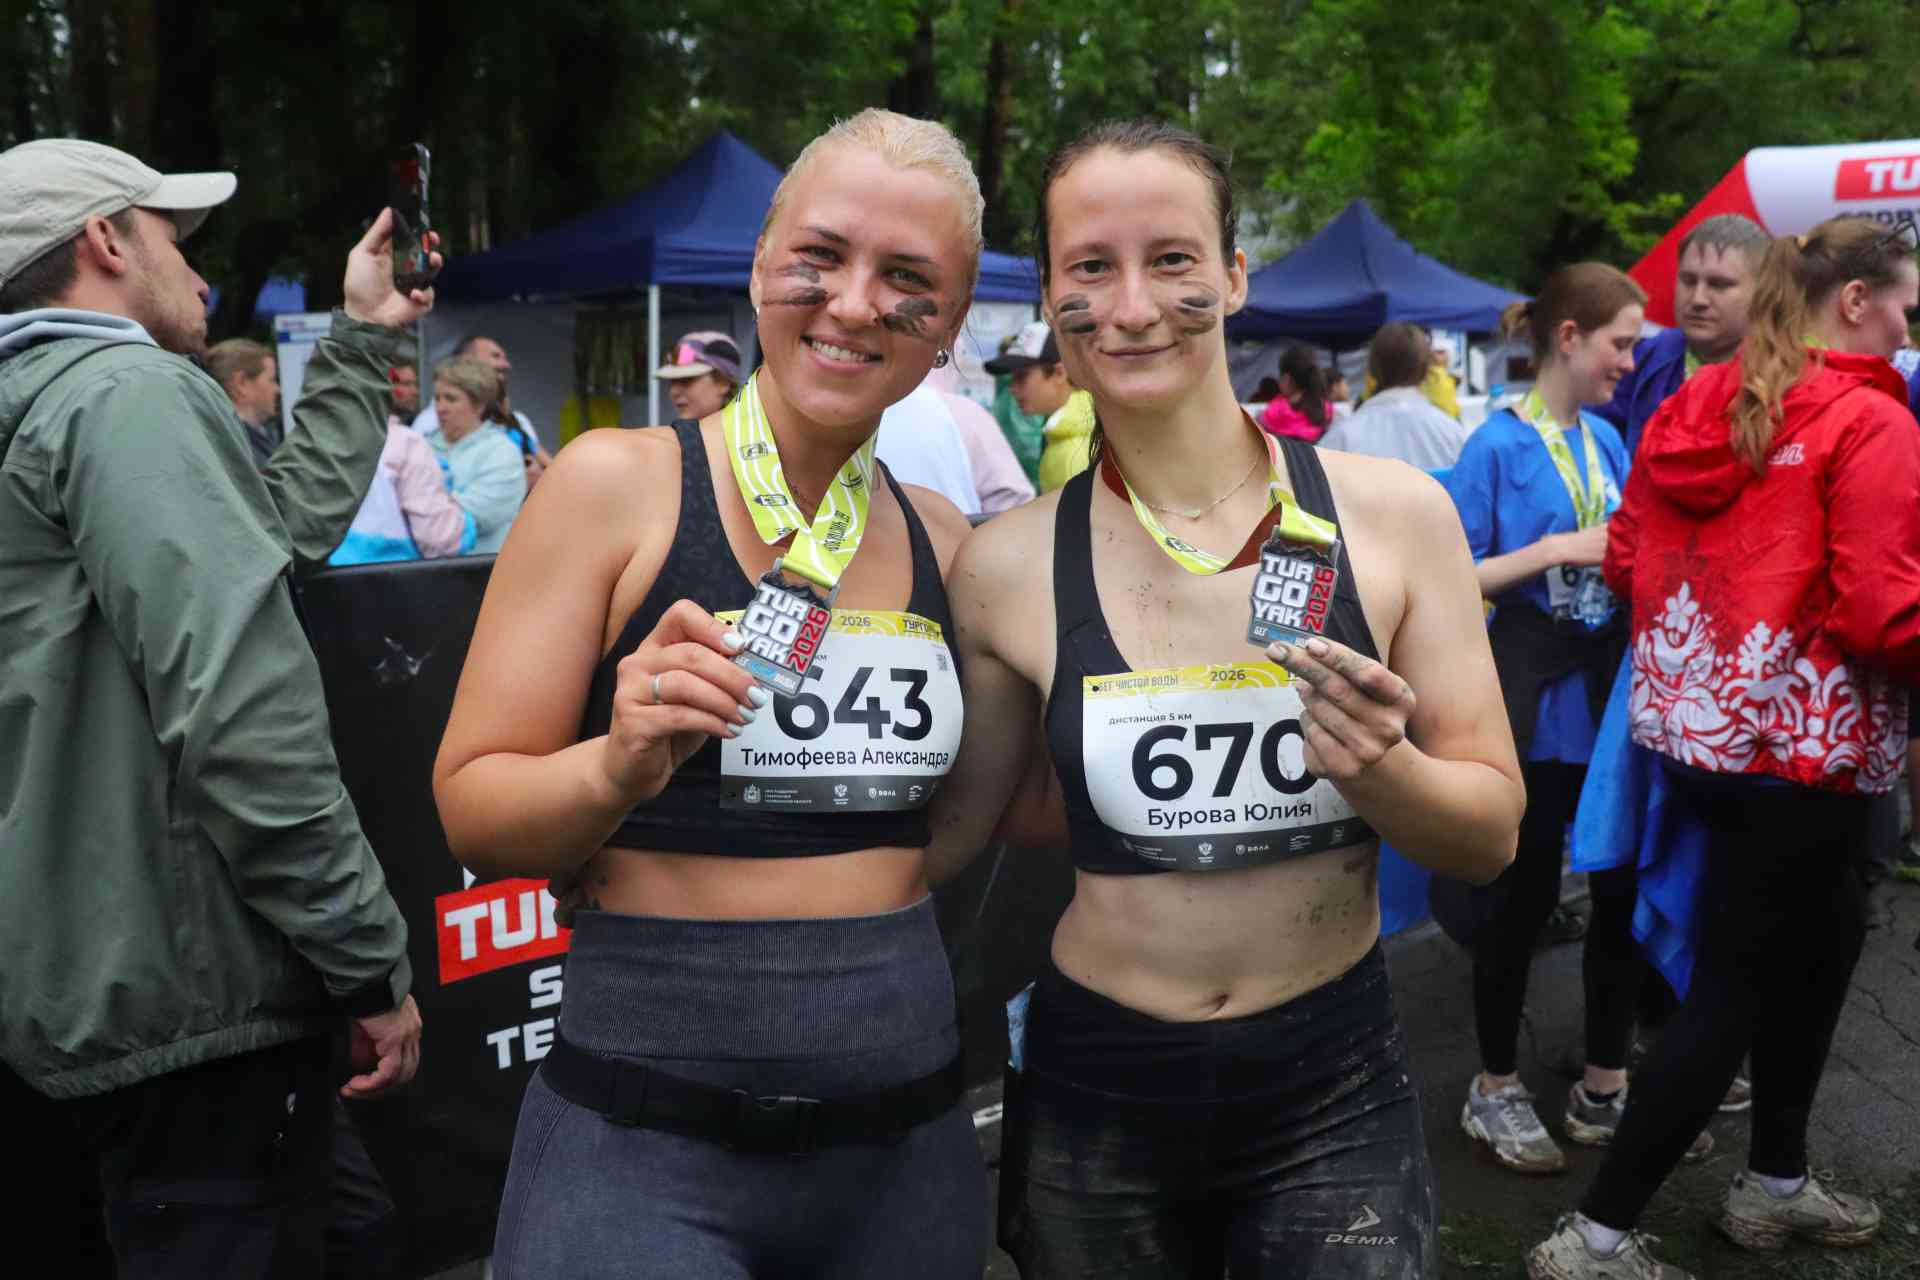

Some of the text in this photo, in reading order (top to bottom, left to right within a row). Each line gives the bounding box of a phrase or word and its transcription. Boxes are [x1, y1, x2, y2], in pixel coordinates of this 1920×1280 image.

[1263, 552, 1314, 582] TUR
[758, 581, 809, 620] TUR
[1255, 574, 1309, 608] GO
[1301, 565, 1335, 633] 2026
[744, 601, 800, 645] GO
[840, 615, 871, 626] 2026
[1253, 599, 1305, 628] YAK
[785, 606, 829, 674] 2026
[1116, 675, 1149, 690] ЧИСТОЙ
[1151, 674, 1178, 688] ВОДЫ
[1210, 670, 1246, 682] 2026
[773, 665, 933, 741] 643
[1108, 713, 1192, 726] дистанция 5 км
[741, 747, 949, 770] Тимофеева Александра
[1132, 719, 1319, 801] 670
[1148, 803, 1312, 829] Бурова Юлия
[1325, 1234, 1399, 1246] DEMIX
